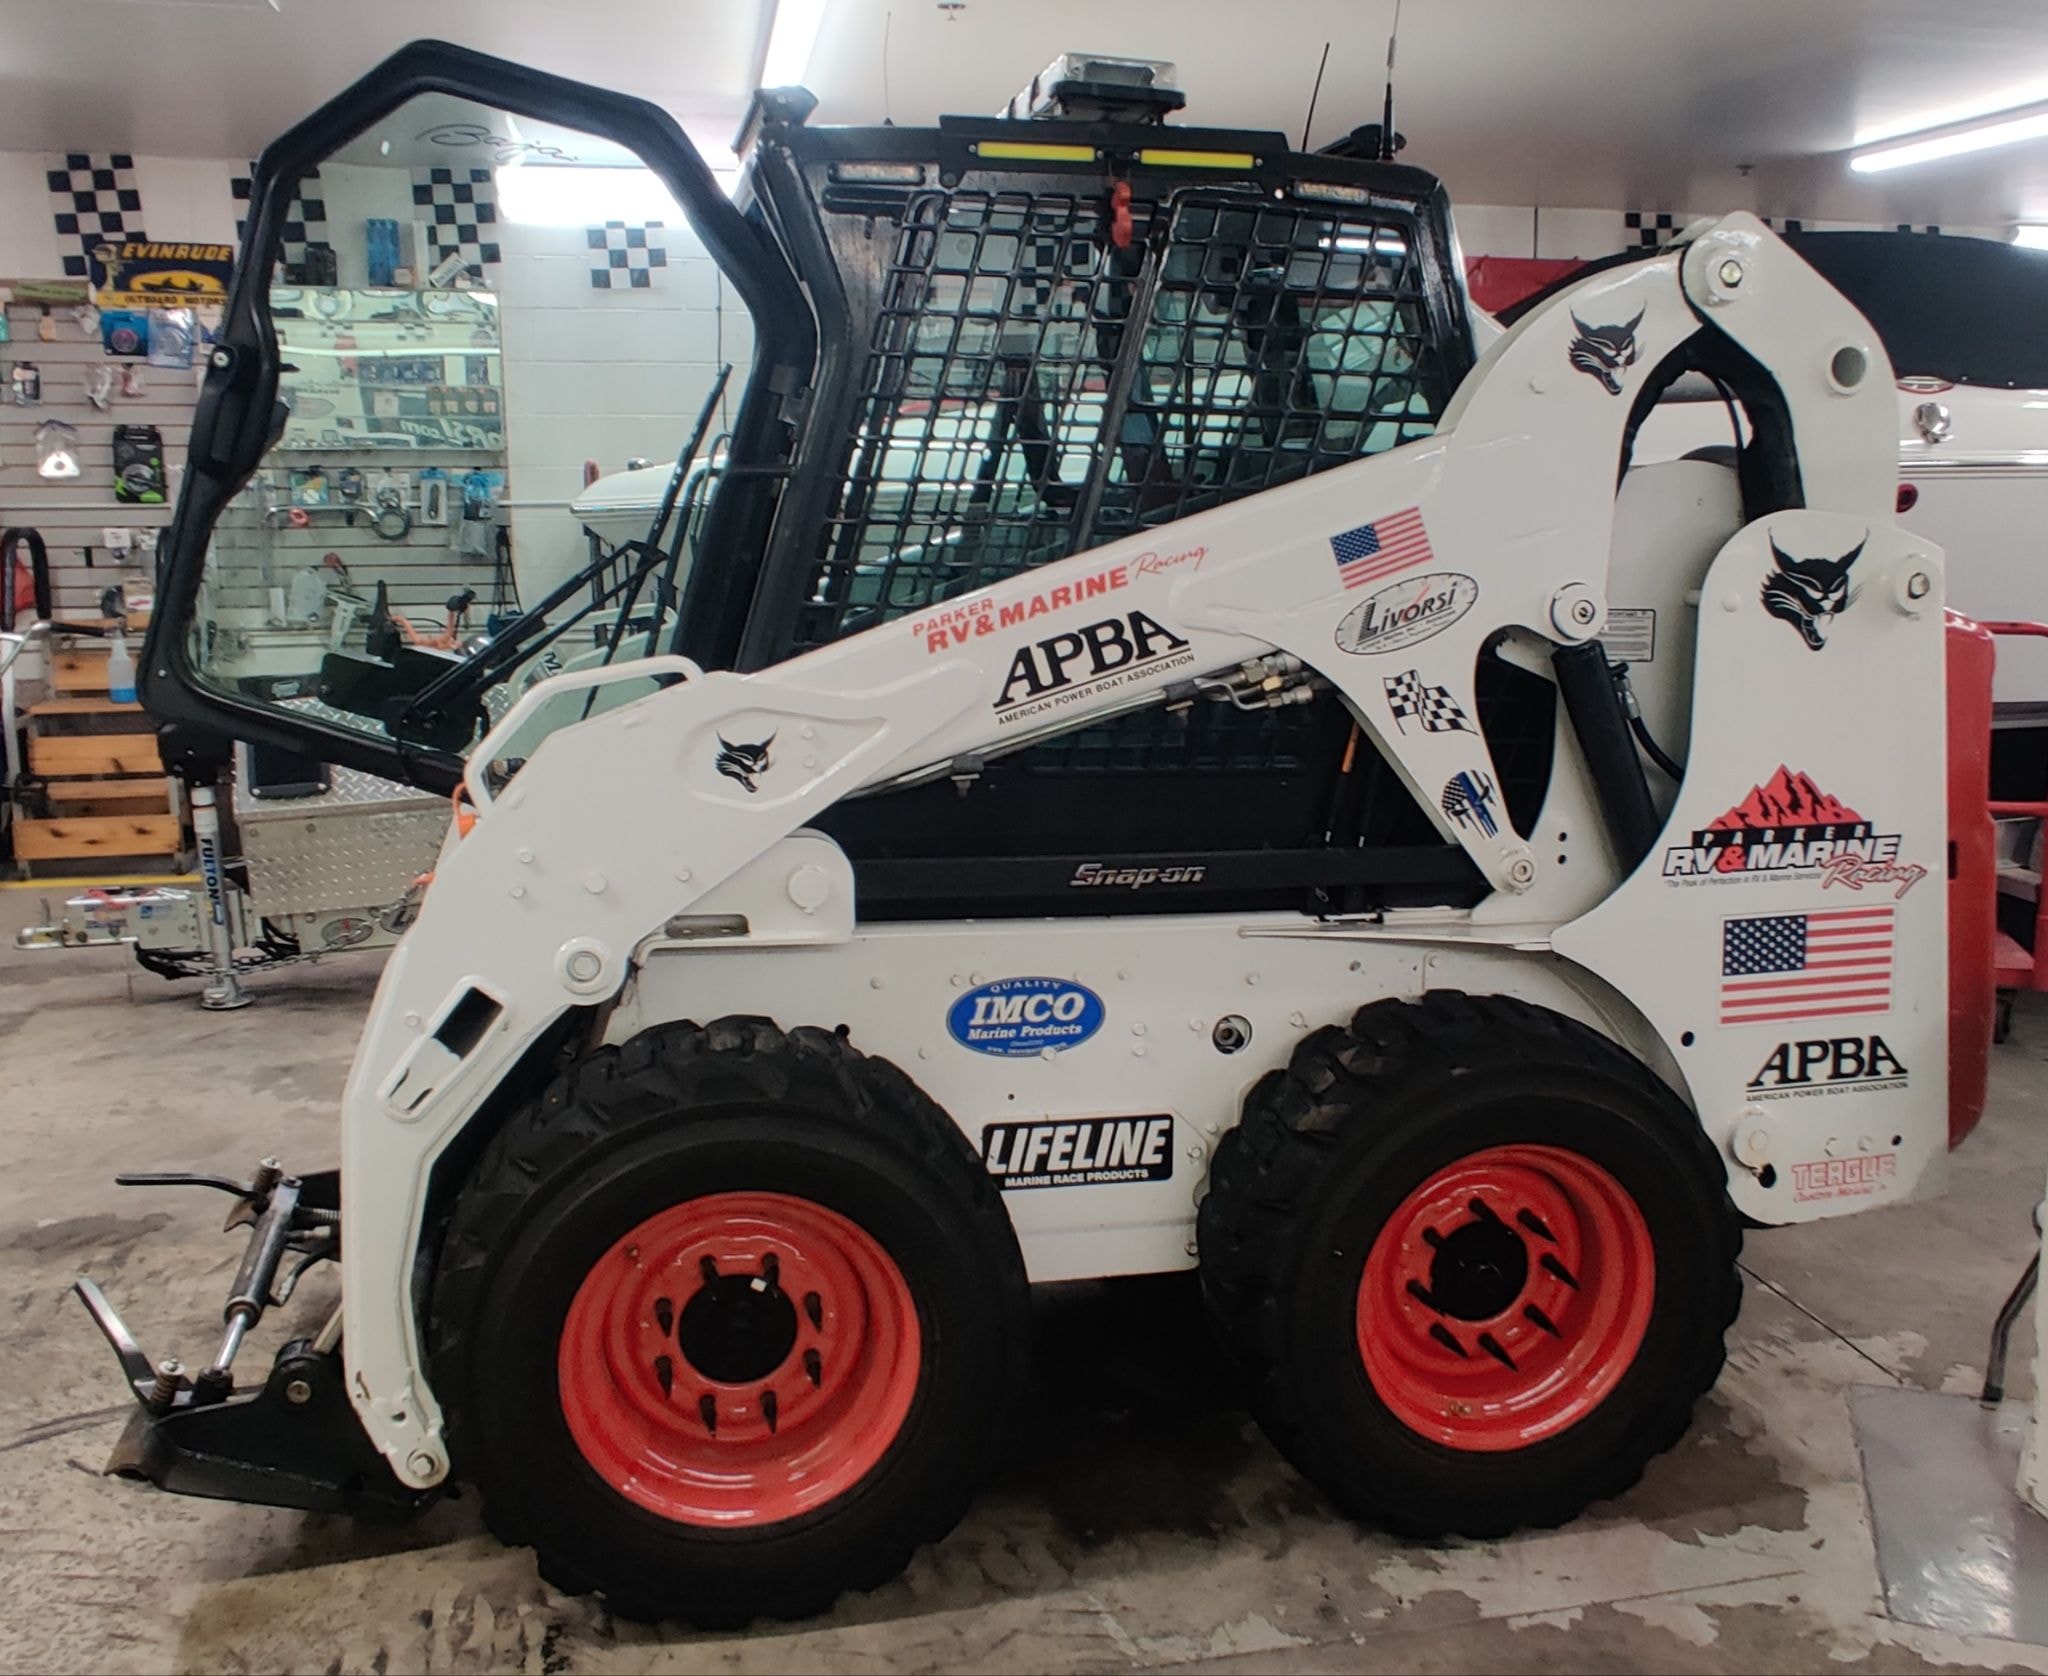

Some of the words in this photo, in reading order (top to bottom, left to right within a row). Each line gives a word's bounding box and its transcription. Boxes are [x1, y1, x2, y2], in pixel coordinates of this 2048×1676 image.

[122, 243, 232, 261] EVINRUDE
[1130, 545, 1209, 581] Racing
[912, 598, 995, 636] PARKER
[993, 610, 1189, 708] APBA
[998, 700, 1051, 726] AMERICAN
[1055, 687, 1093, 706] POWER
[1096, 677, 1123, 692] BOAT
[1127, 653, 1195, 683] ASSOCIATION
[1703, 825, 1867, 846] PARKER
[200, 837, 220, 904] FULTON
[1070, 863, 1206, 890] Snap-on
[1821, 854, 1928, 899] Racing
[991, 980, 1062, 993] QUALITY
[969, 992, 1086, 1026] IMCO
[968, 1028, 1017, 1040] Marine
[1020, 1024, 1082, 1037] Products
[1747, 1035, 1908, 1087] APBA
[1746, 1092, 1790, 1102] AMERICAN
[1793, 1088, 1824, 1098] POWER
[1827, 1086, 1850, 1095] BOAT
[1852, 1082, 1909, 1093] ASSOCIATION
[986, 1119, 1172, 1175] LIFELINE
[1005, 1175, 1051, 1187] MARINE
[1053, 1172, 1085, 1185] RACE
[1087, 1169, 1149, 1182] PRODUCTS
[1791, 1153, 1897, 1190] TEAGUE
